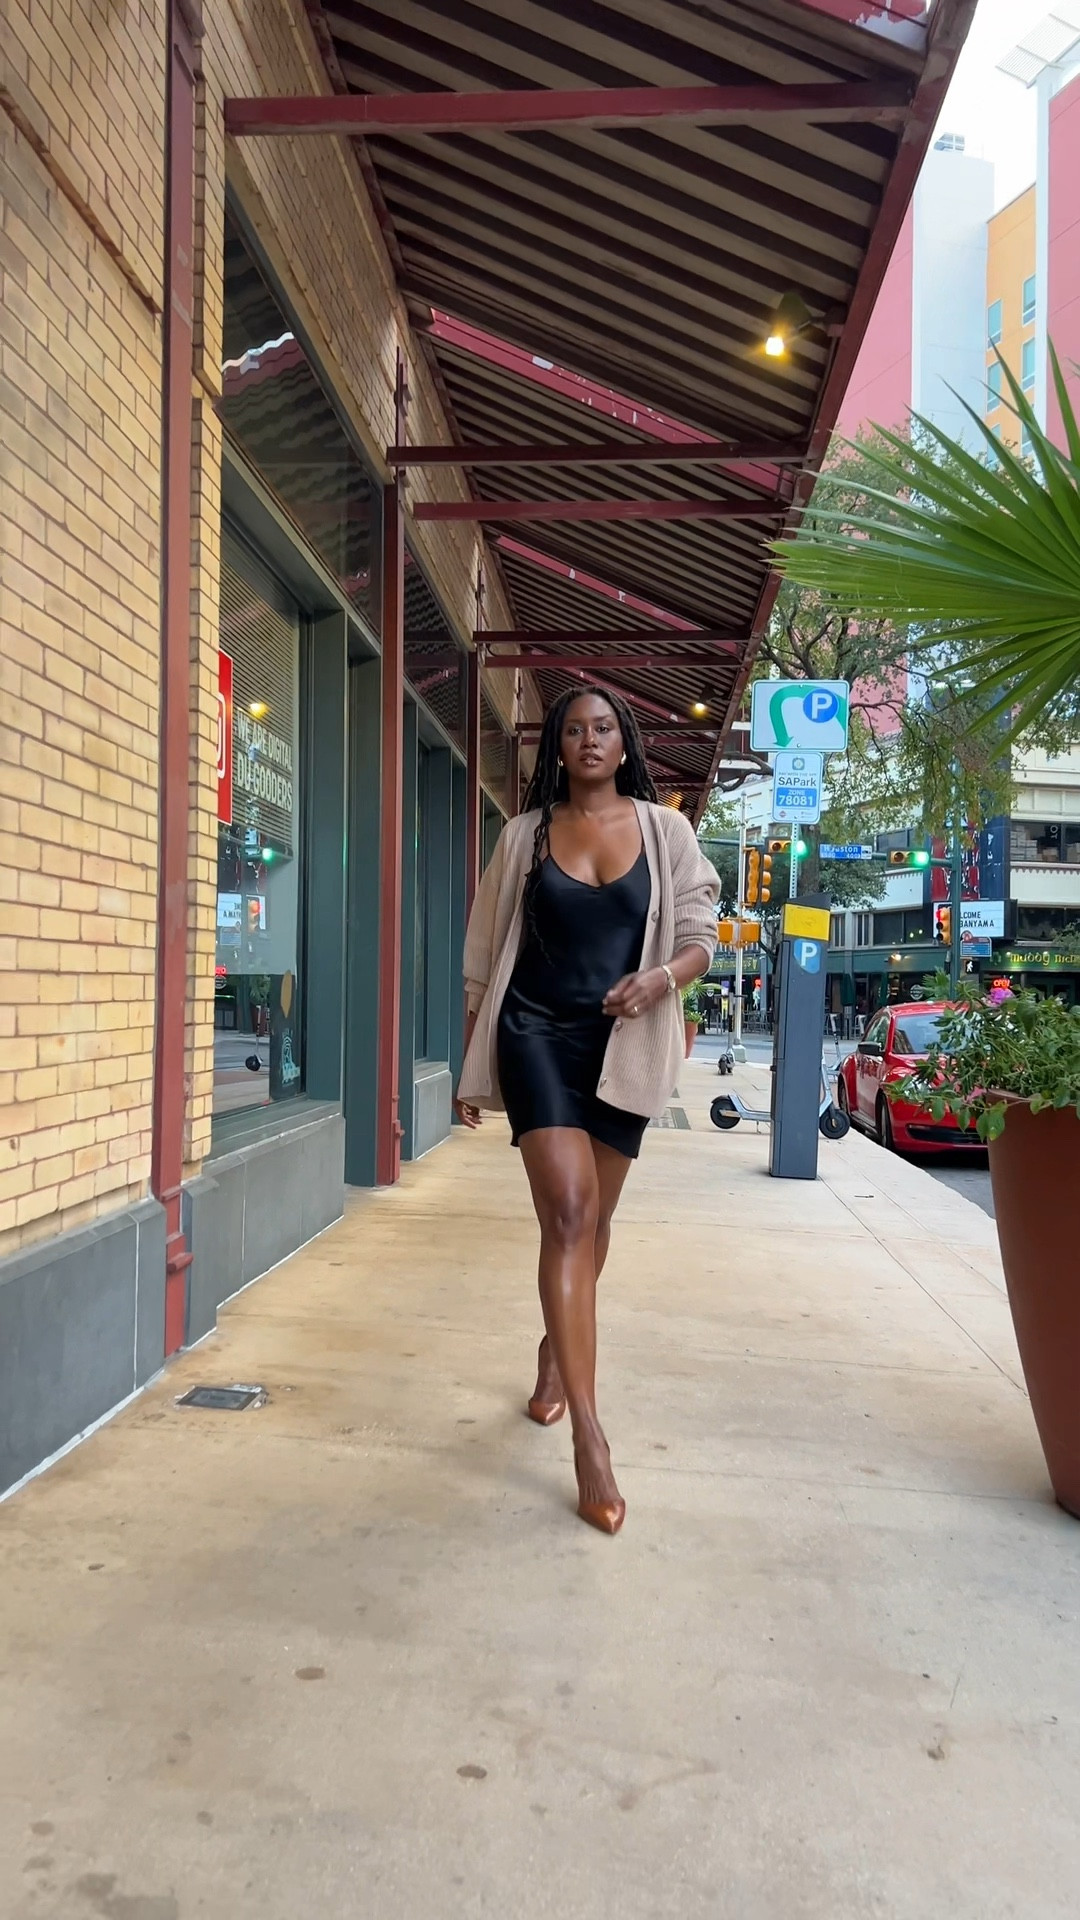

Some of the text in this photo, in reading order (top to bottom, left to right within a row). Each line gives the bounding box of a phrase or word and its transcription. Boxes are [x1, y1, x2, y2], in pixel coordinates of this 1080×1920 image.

[812, 693, 832, 719] P
[237, 709, 250, 744] WE
[252, 721, 267, 756] ARE
[268, 731, 292, 772] DIGITAL
[778, 777, 817, 786] SAPark
[778, 795, 813, 806] 78081
